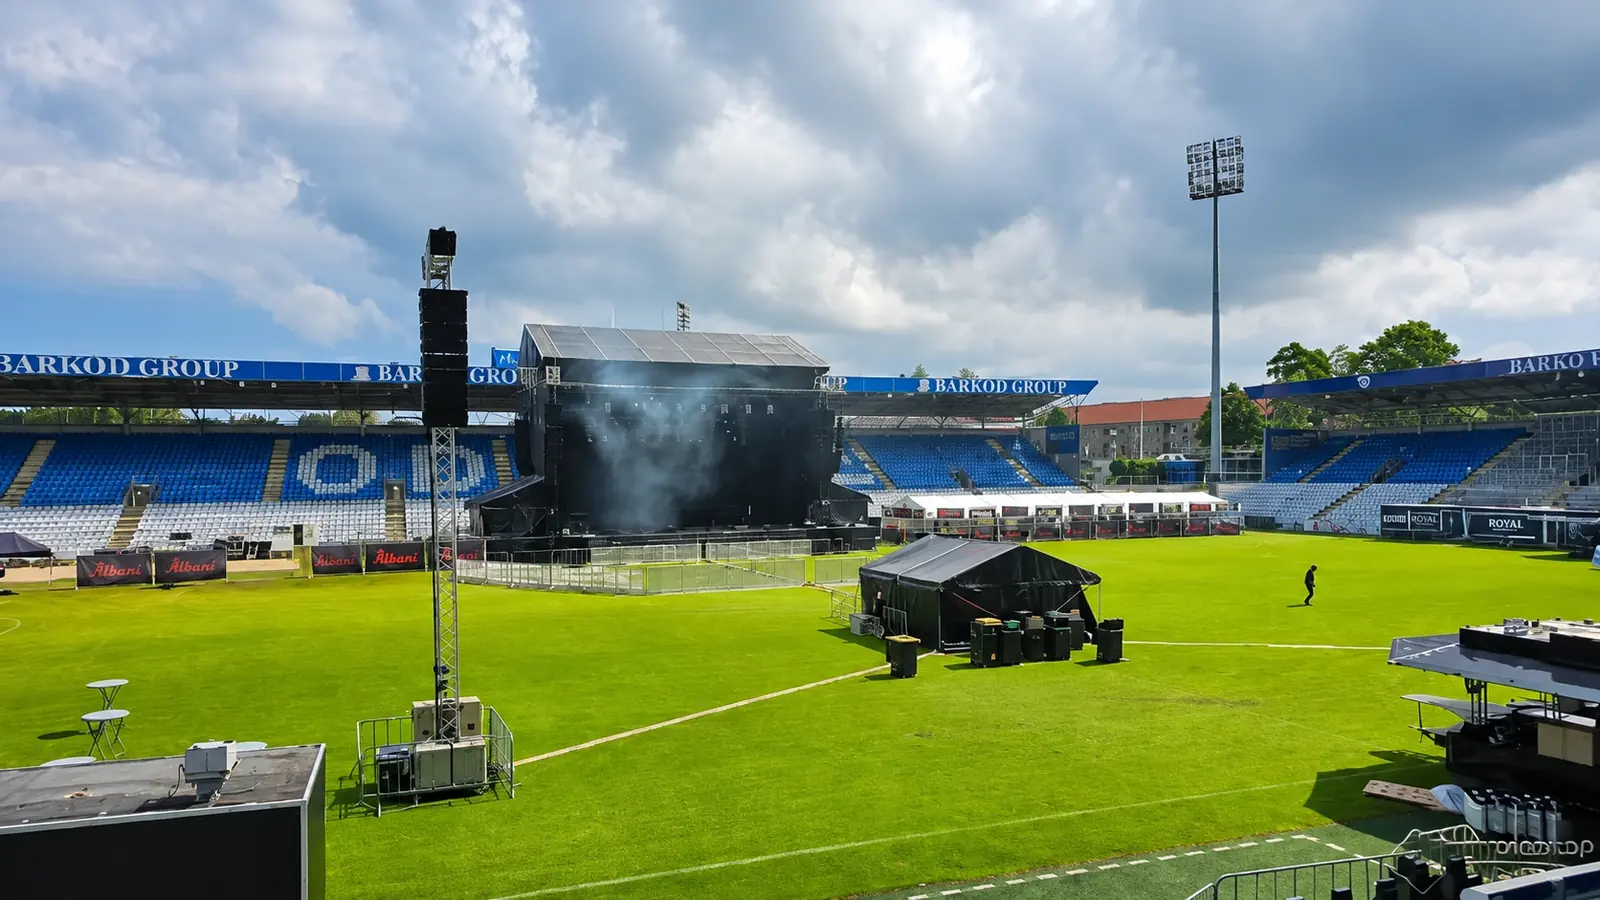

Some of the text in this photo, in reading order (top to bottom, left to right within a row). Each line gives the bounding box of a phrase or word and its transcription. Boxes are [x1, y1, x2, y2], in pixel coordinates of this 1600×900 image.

[0, 354, 239, 378] BARKOD GROUP
[1509, 352, 1584, 374] BARKO
[935, 378, 1067, 395] BARKOD GROUP
[1411, 514, 1439, 524] ROYAL
[1488, 518, 1524, 529] ROYAL
